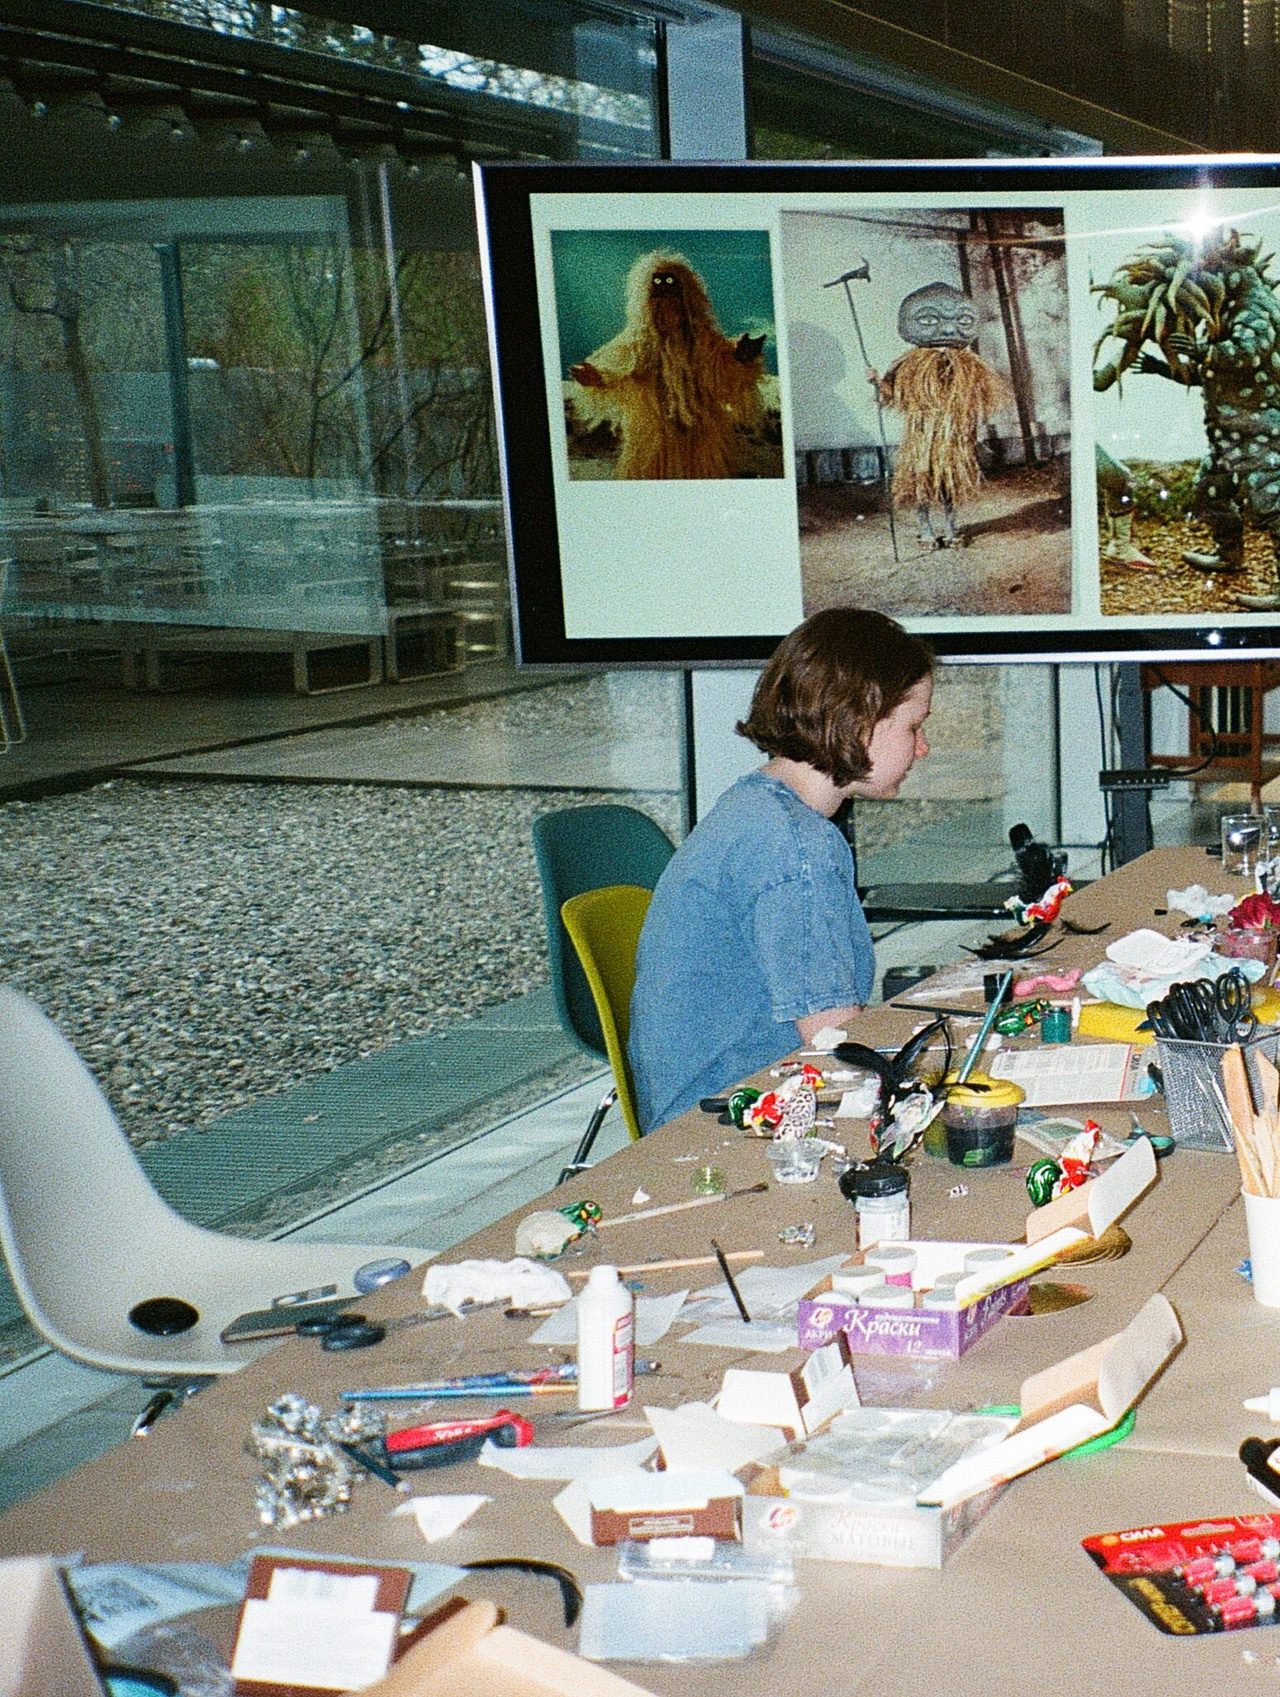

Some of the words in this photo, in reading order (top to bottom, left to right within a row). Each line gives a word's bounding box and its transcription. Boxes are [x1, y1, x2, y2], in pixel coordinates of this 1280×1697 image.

[843, 1308, 922, 1343] Краски
[805, 1329, 837, 1341] АКРИ
[1120, 1527, 1165, 1542] СИЛА
